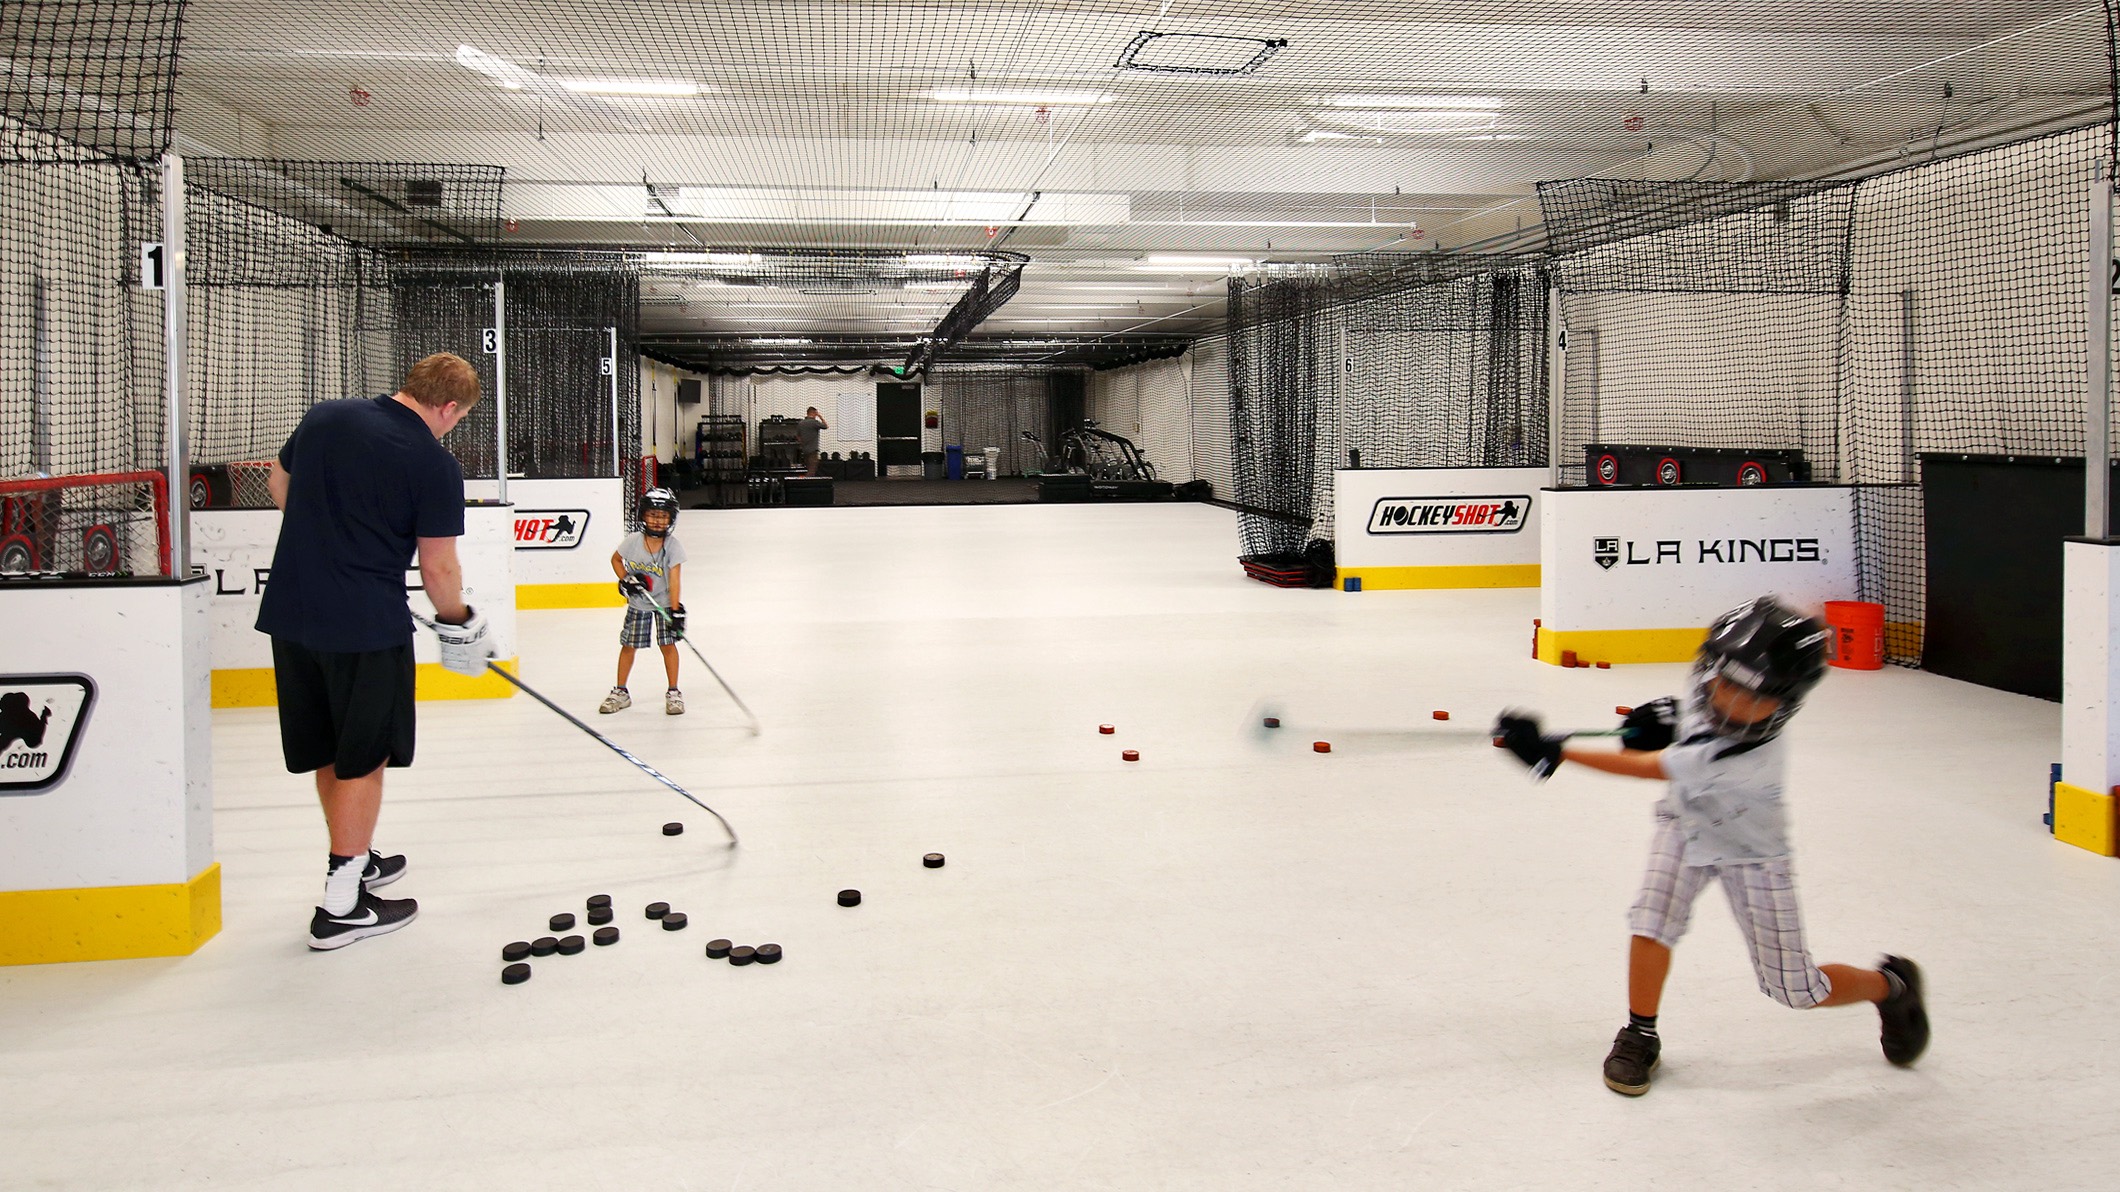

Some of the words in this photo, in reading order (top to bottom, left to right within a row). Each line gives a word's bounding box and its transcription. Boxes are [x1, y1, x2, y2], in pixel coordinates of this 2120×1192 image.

[148, 245, 163, 287] 1
[485, 330, 497, 352] 3
[1558, 330, 1567, 351] 4
[602, 359, 611, 374] 5
[1345, 358, 1353, 373] 6
[1379, 504, 1501, 527] HOCKEYSHOT
[514, 518, 555, 541] HOT
[1698, 538, 1820, 563] KINGS
[1, 752, 48, 769] .com
